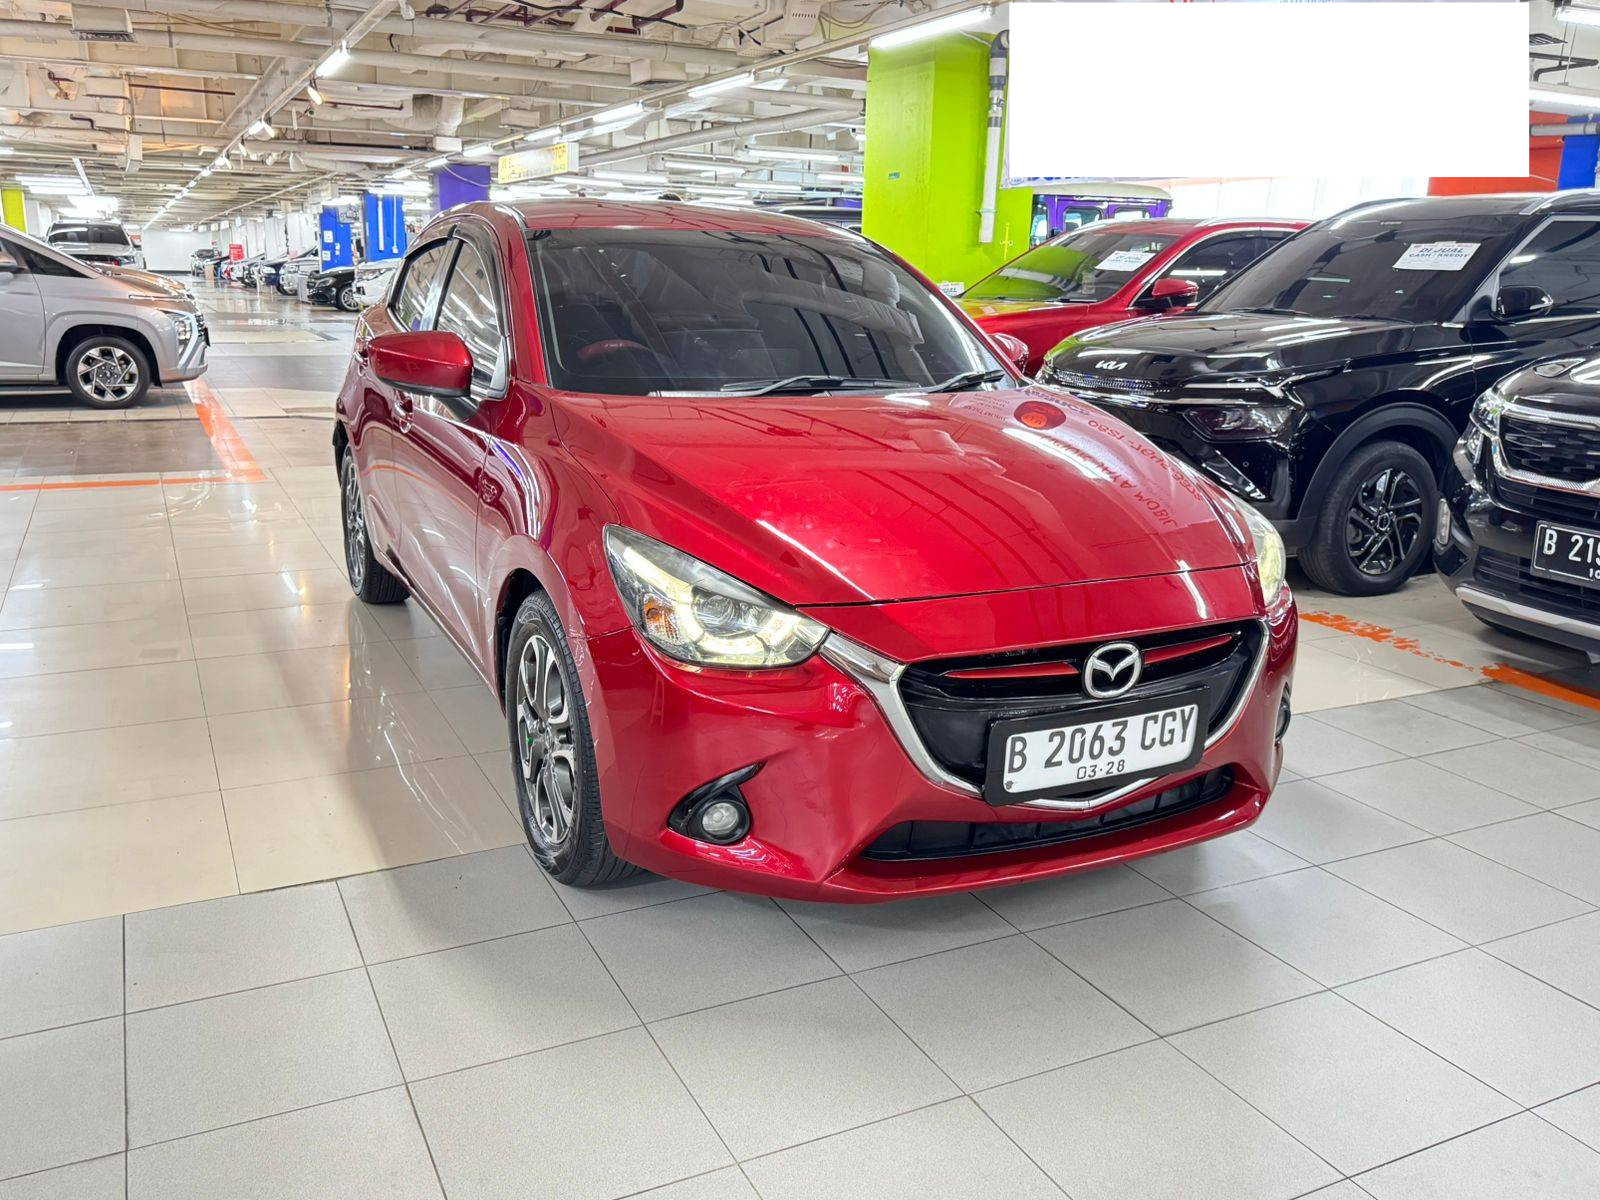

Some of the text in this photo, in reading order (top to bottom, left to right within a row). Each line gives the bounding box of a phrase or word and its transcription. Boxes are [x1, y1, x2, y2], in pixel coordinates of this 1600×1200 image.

[1543, 528, 1557, 555] B
[1008, 707, 1195, 774] B 2063 CGY
